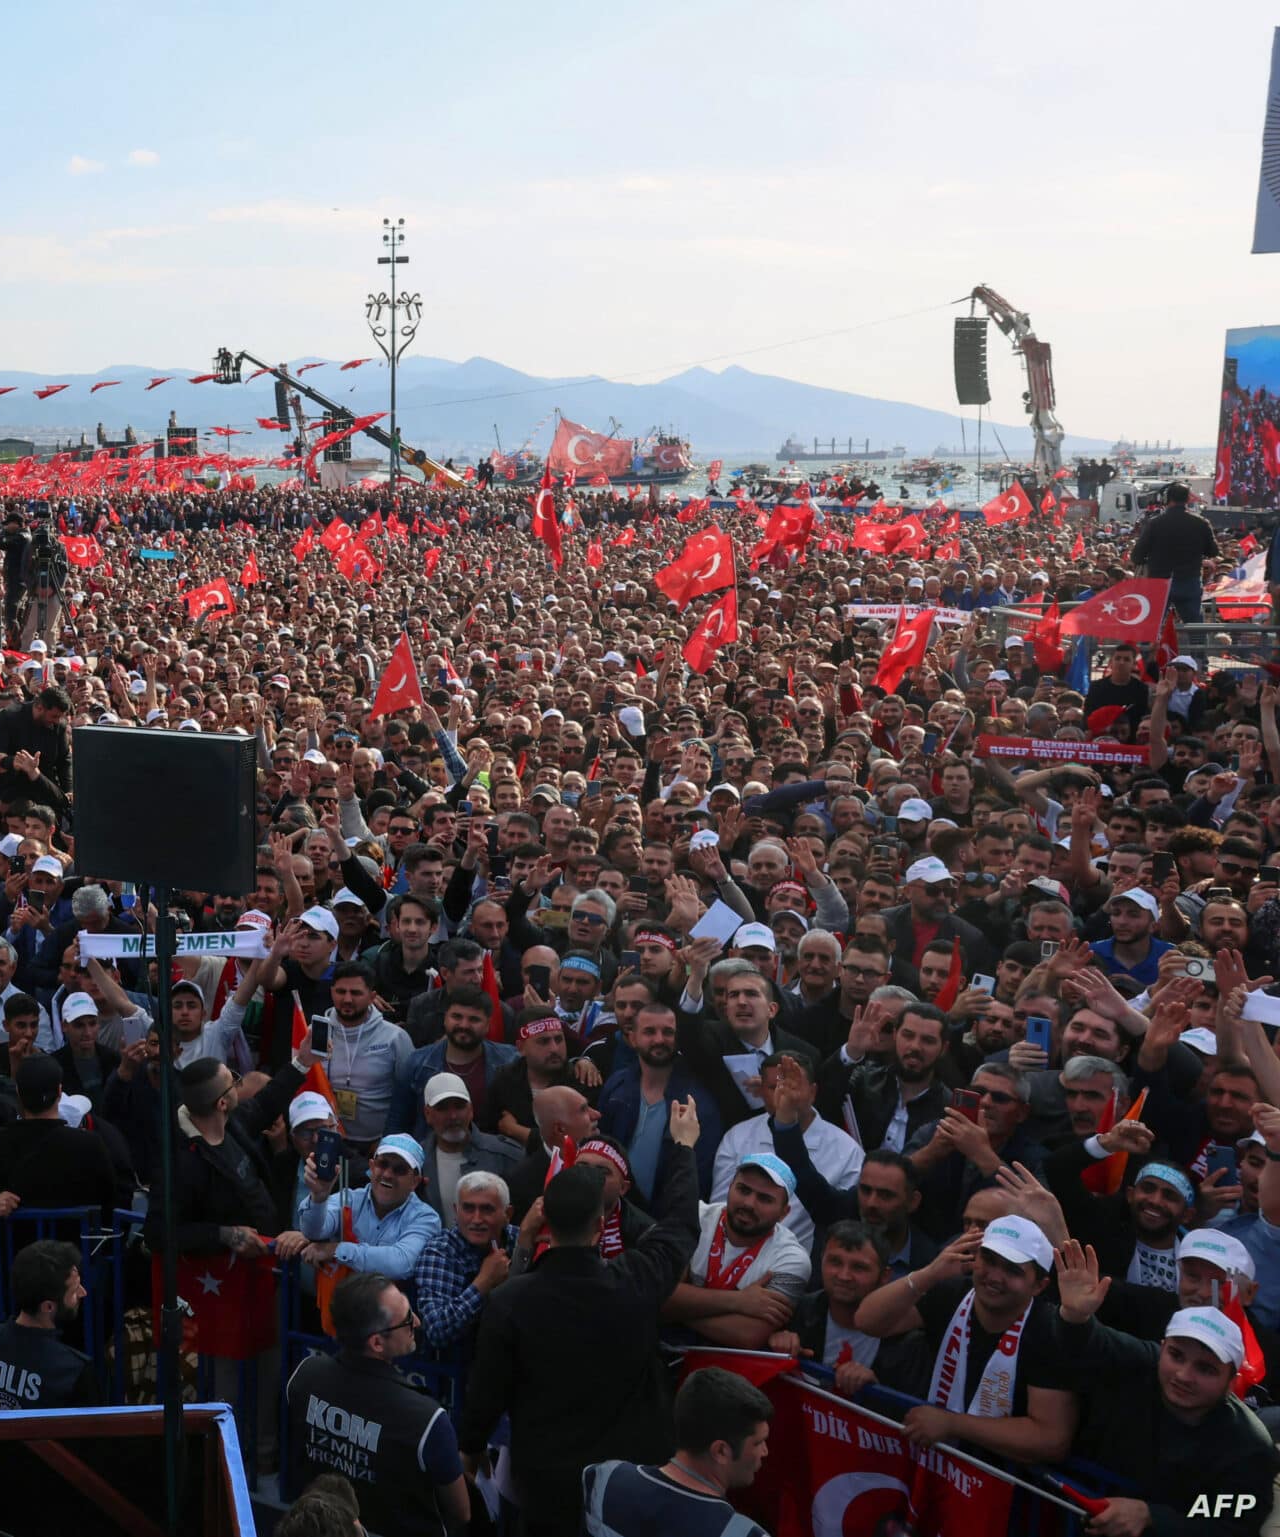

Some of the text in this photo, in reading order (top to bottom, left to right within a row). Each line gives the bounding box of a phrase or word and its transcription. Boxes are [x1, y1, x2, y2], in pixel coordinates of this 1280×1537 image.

[122, 934, 235, 952] MEEMEN
[306, 1394, 382, 1453] KOM
[857, 1426, 903, 1455] DUR
